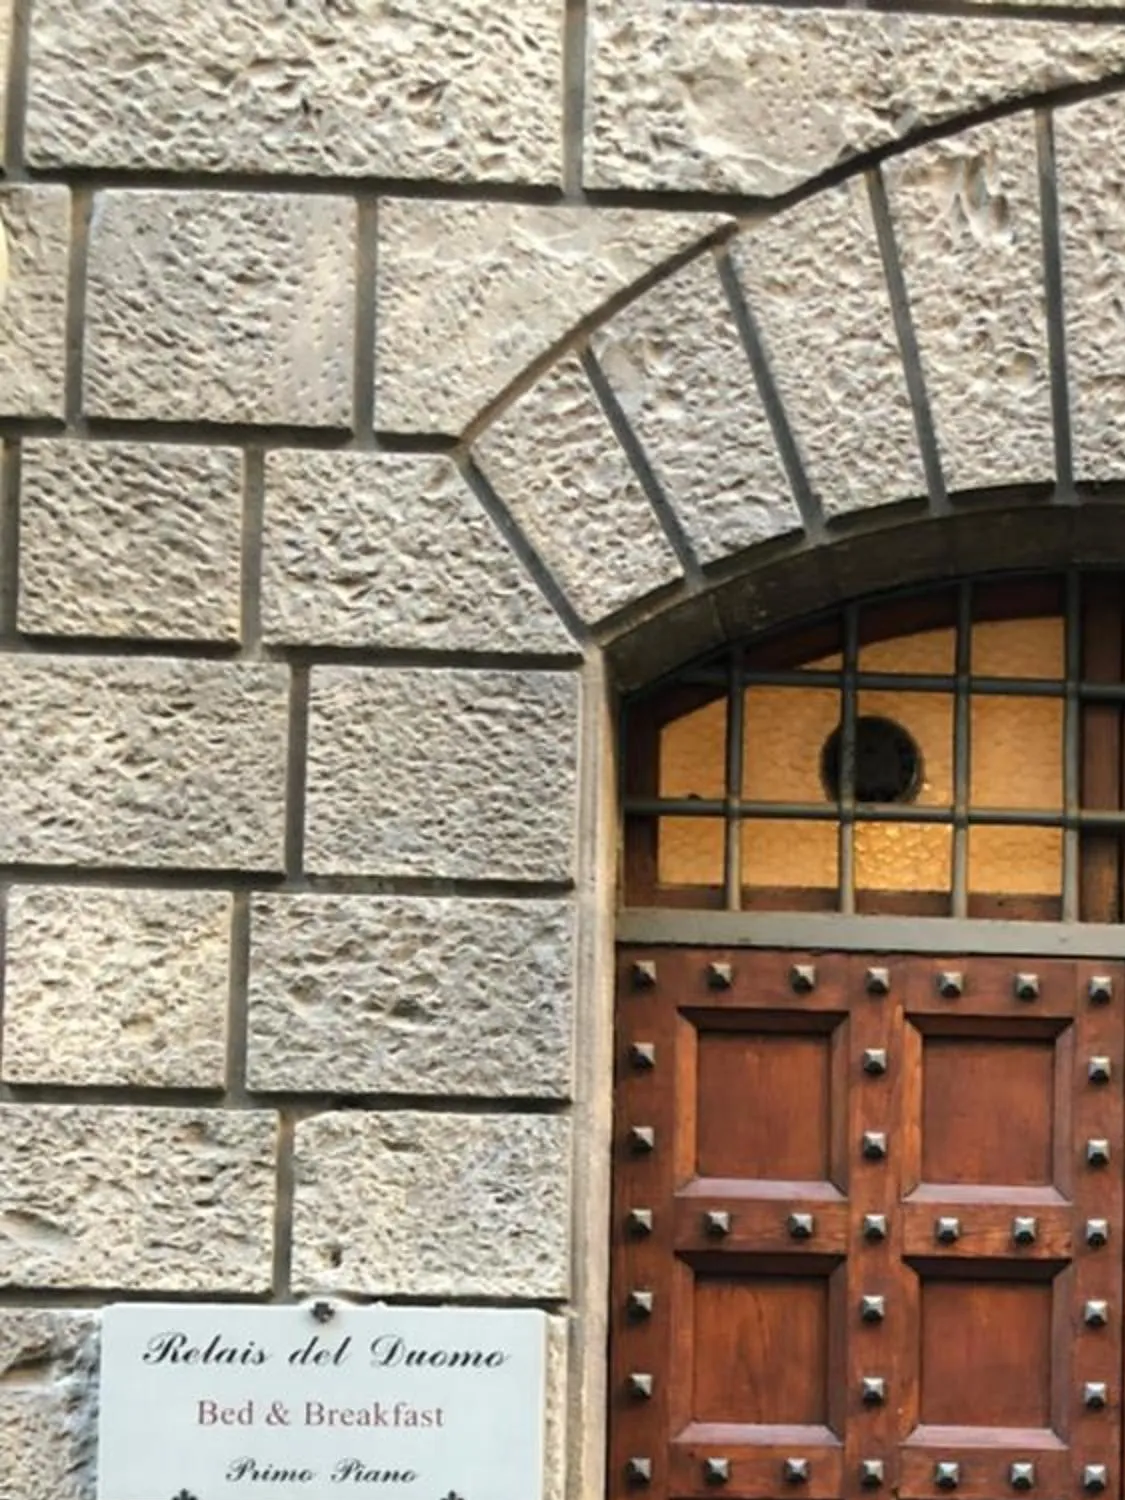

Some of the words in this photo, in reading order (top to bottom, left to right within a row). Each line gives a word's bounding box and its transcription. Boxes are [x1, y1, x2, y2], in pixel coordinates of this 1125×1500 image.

[142, 1331, 270, 1366] Relais
[288, 1336, 352, 1366] del
[370, 1336, 510, 1368] Duomo
[197, 1400, 254, 1426] Bed
[265, 1402, 290, 1426] &
[304, 1401, 443, 1428] Breakfast
[225, 1457, 316, 1483] Primo
[330, 1458, 418, 1484] Piano
